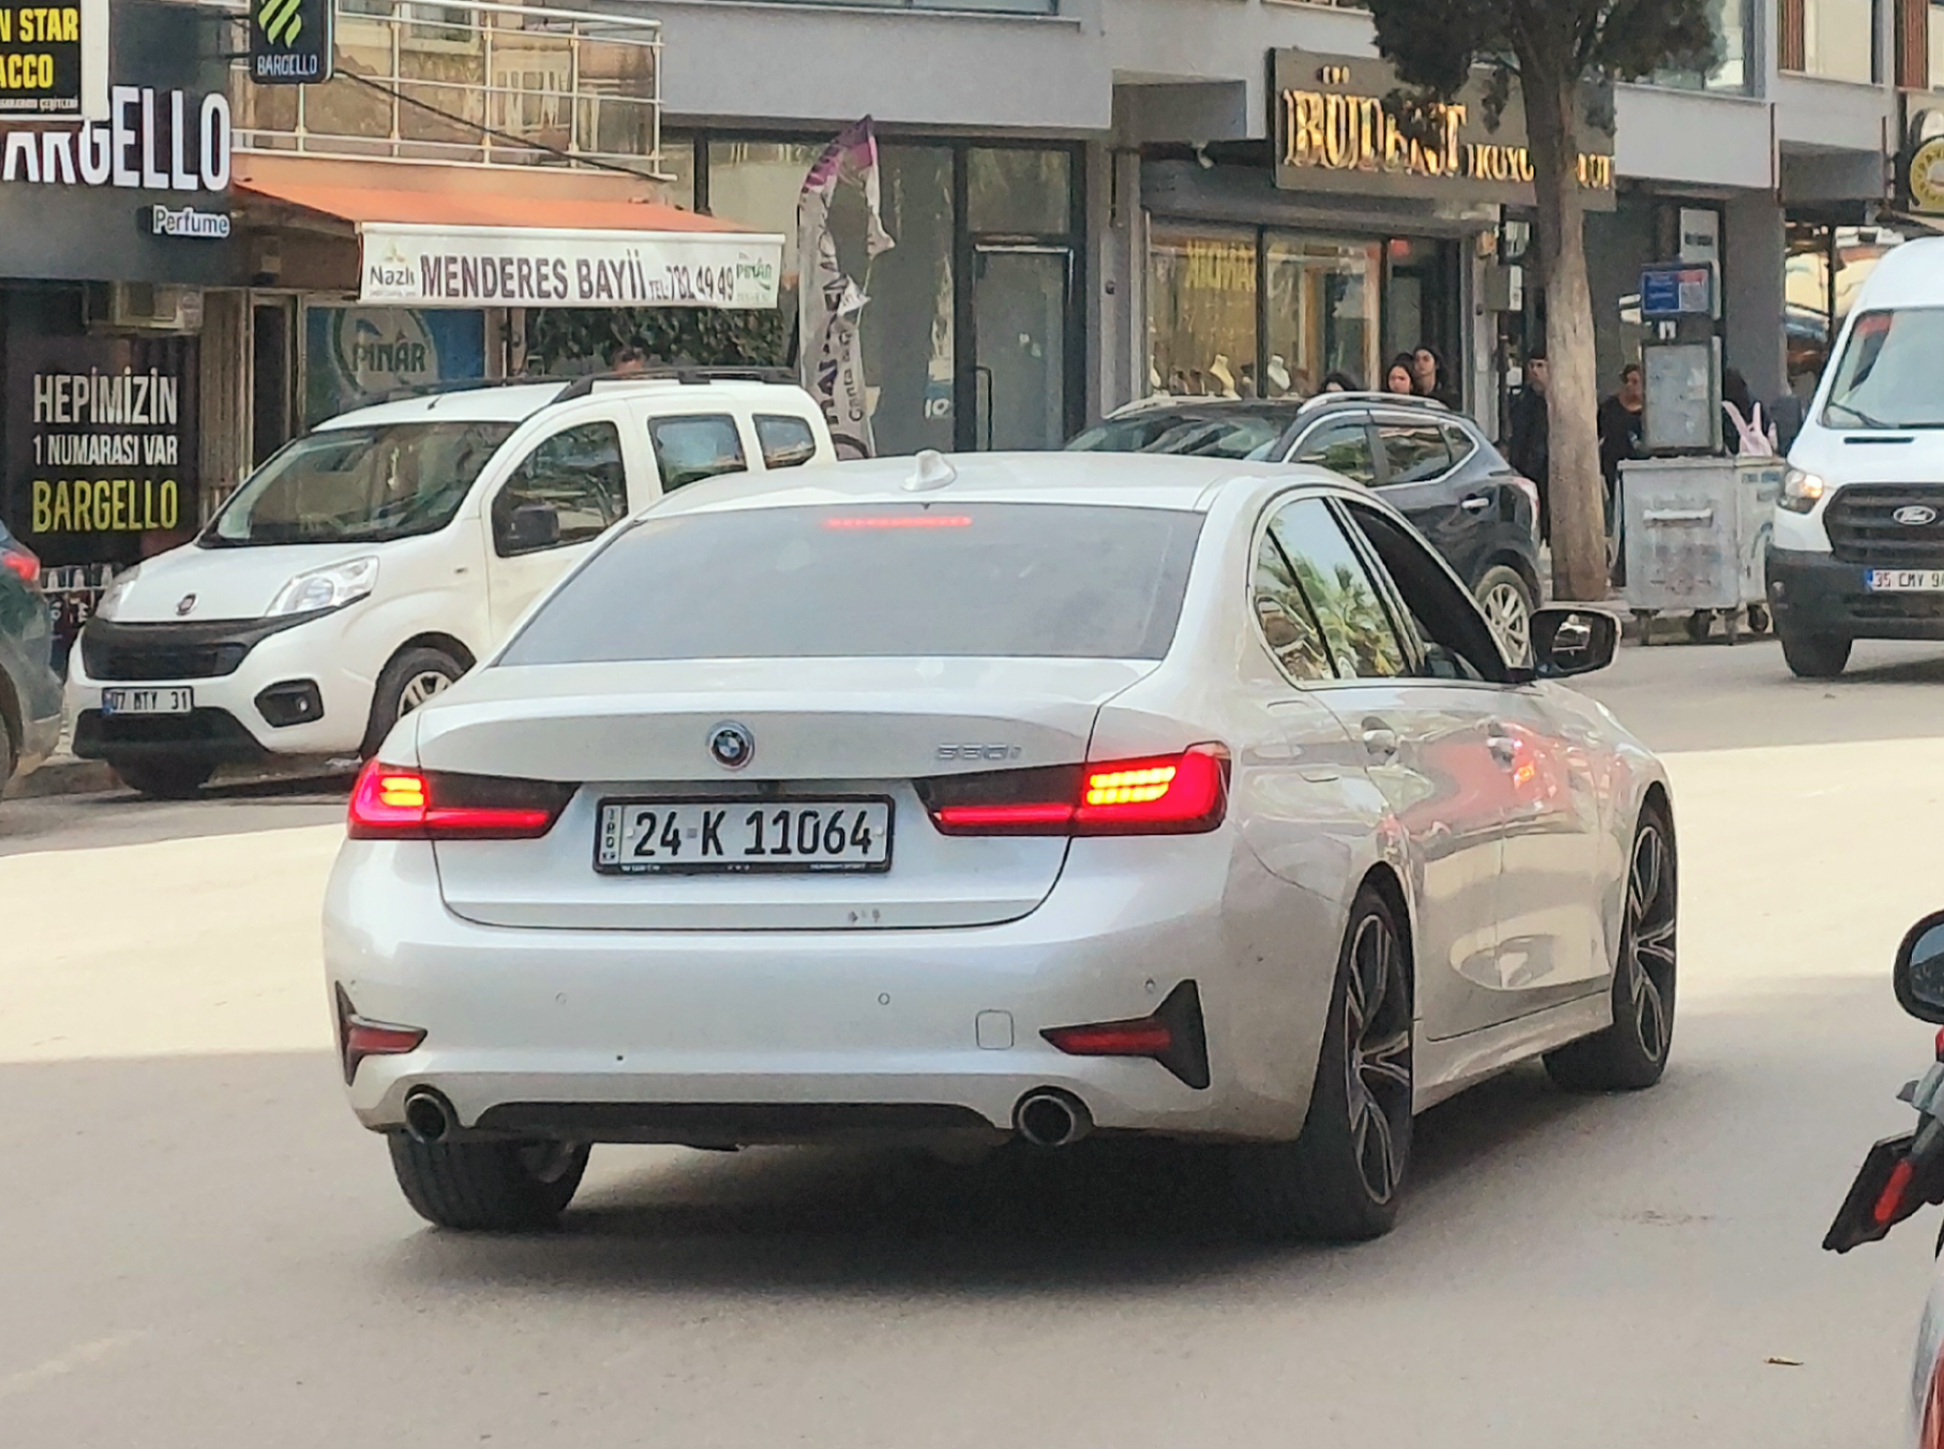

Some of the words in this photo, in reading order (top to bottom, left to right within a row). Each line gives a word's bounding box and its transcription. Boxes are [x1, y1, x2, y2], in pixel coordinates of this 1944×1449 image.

[20, 8, 78, 42] STAR
[257, 54, 318, 76] BARGELLO
[153, 205, 230, 236] Perfume
[420, 255, 568, 299] MENDERES
[696, 265, 714, 299] 49
[718, 265, 734, 300] 49
[33, 366, 177, 424] HEPİMİZİN
[33, 434, 42, 465] 1
[47, 434, 139, 465] NUMARASI
[143, 434, 178, 465] VAR
[32, 479, 177, 533] BARGELLO
[1931, 572, 1944, 588] 9
[171, 690, 187, 710] 31
[634, 811, 681, 856] 24
[702, 810, 726, 856] K
[744, 809, 872, 855] 11064
